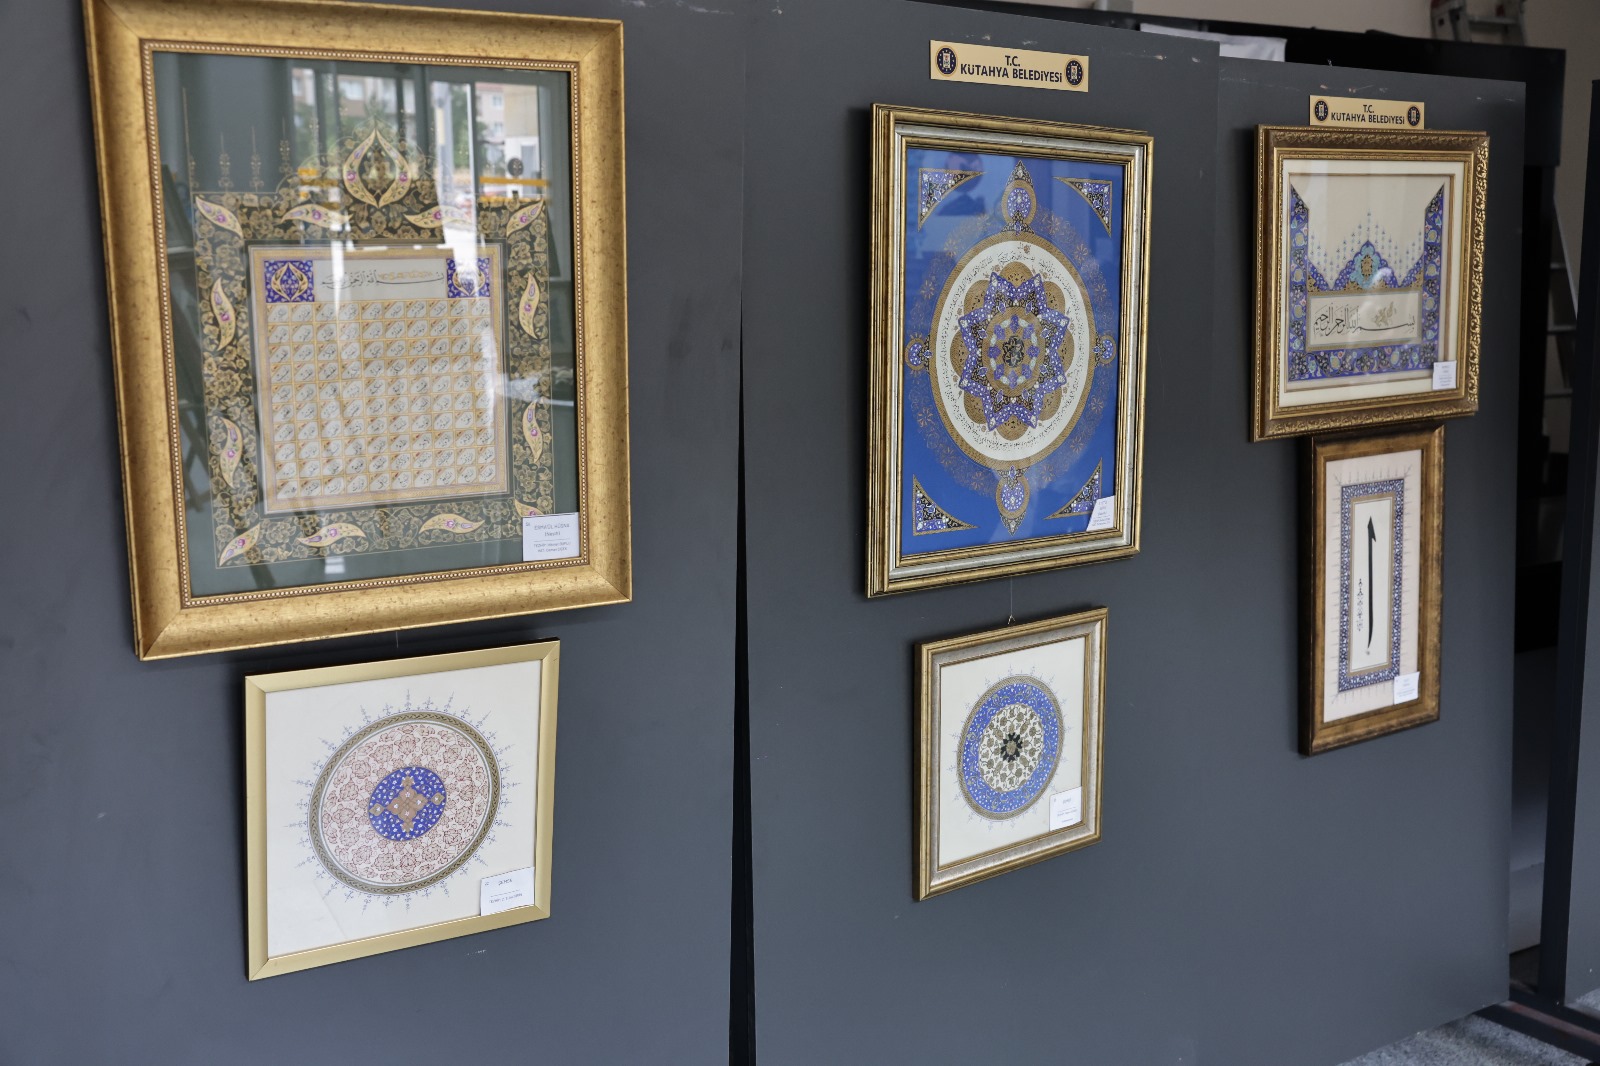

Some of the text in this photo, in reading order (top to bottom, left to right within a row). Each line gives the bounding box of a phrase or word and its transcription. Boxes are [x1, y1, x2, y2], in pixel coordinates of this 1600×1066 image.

[1005, 55, 1020, 67] T.C.
[961, 64, 1062, 83] KÜTAHYA BELEDİYESİ
[1363, 104, 1375, 114] T.C.
[1331, 112, 1366, 122] KÜTAHYA
